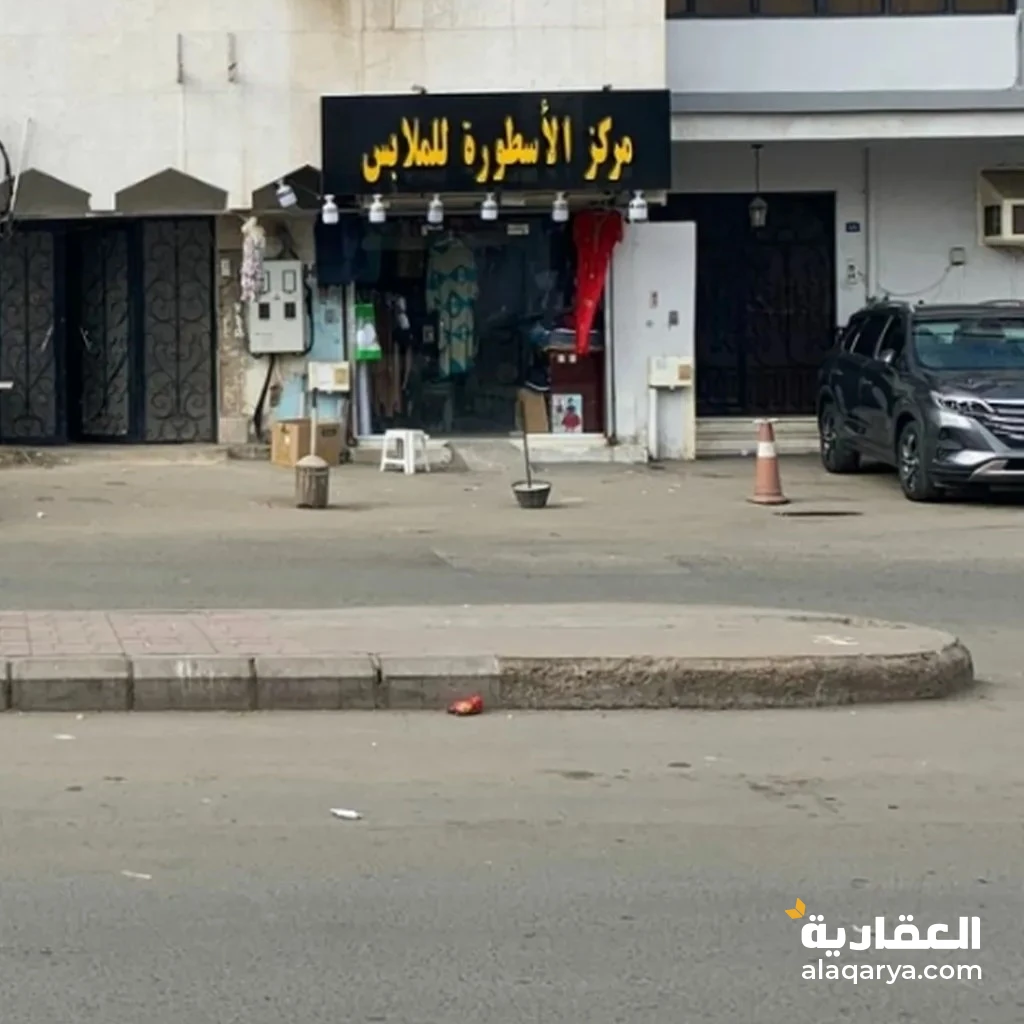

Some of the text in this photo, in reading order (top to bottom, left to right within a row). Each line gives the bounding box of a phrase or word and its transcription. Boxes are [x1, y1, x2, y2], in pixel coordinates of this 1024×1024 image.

[361, 98, 633, 183] مركز الأسطورة للملابس
